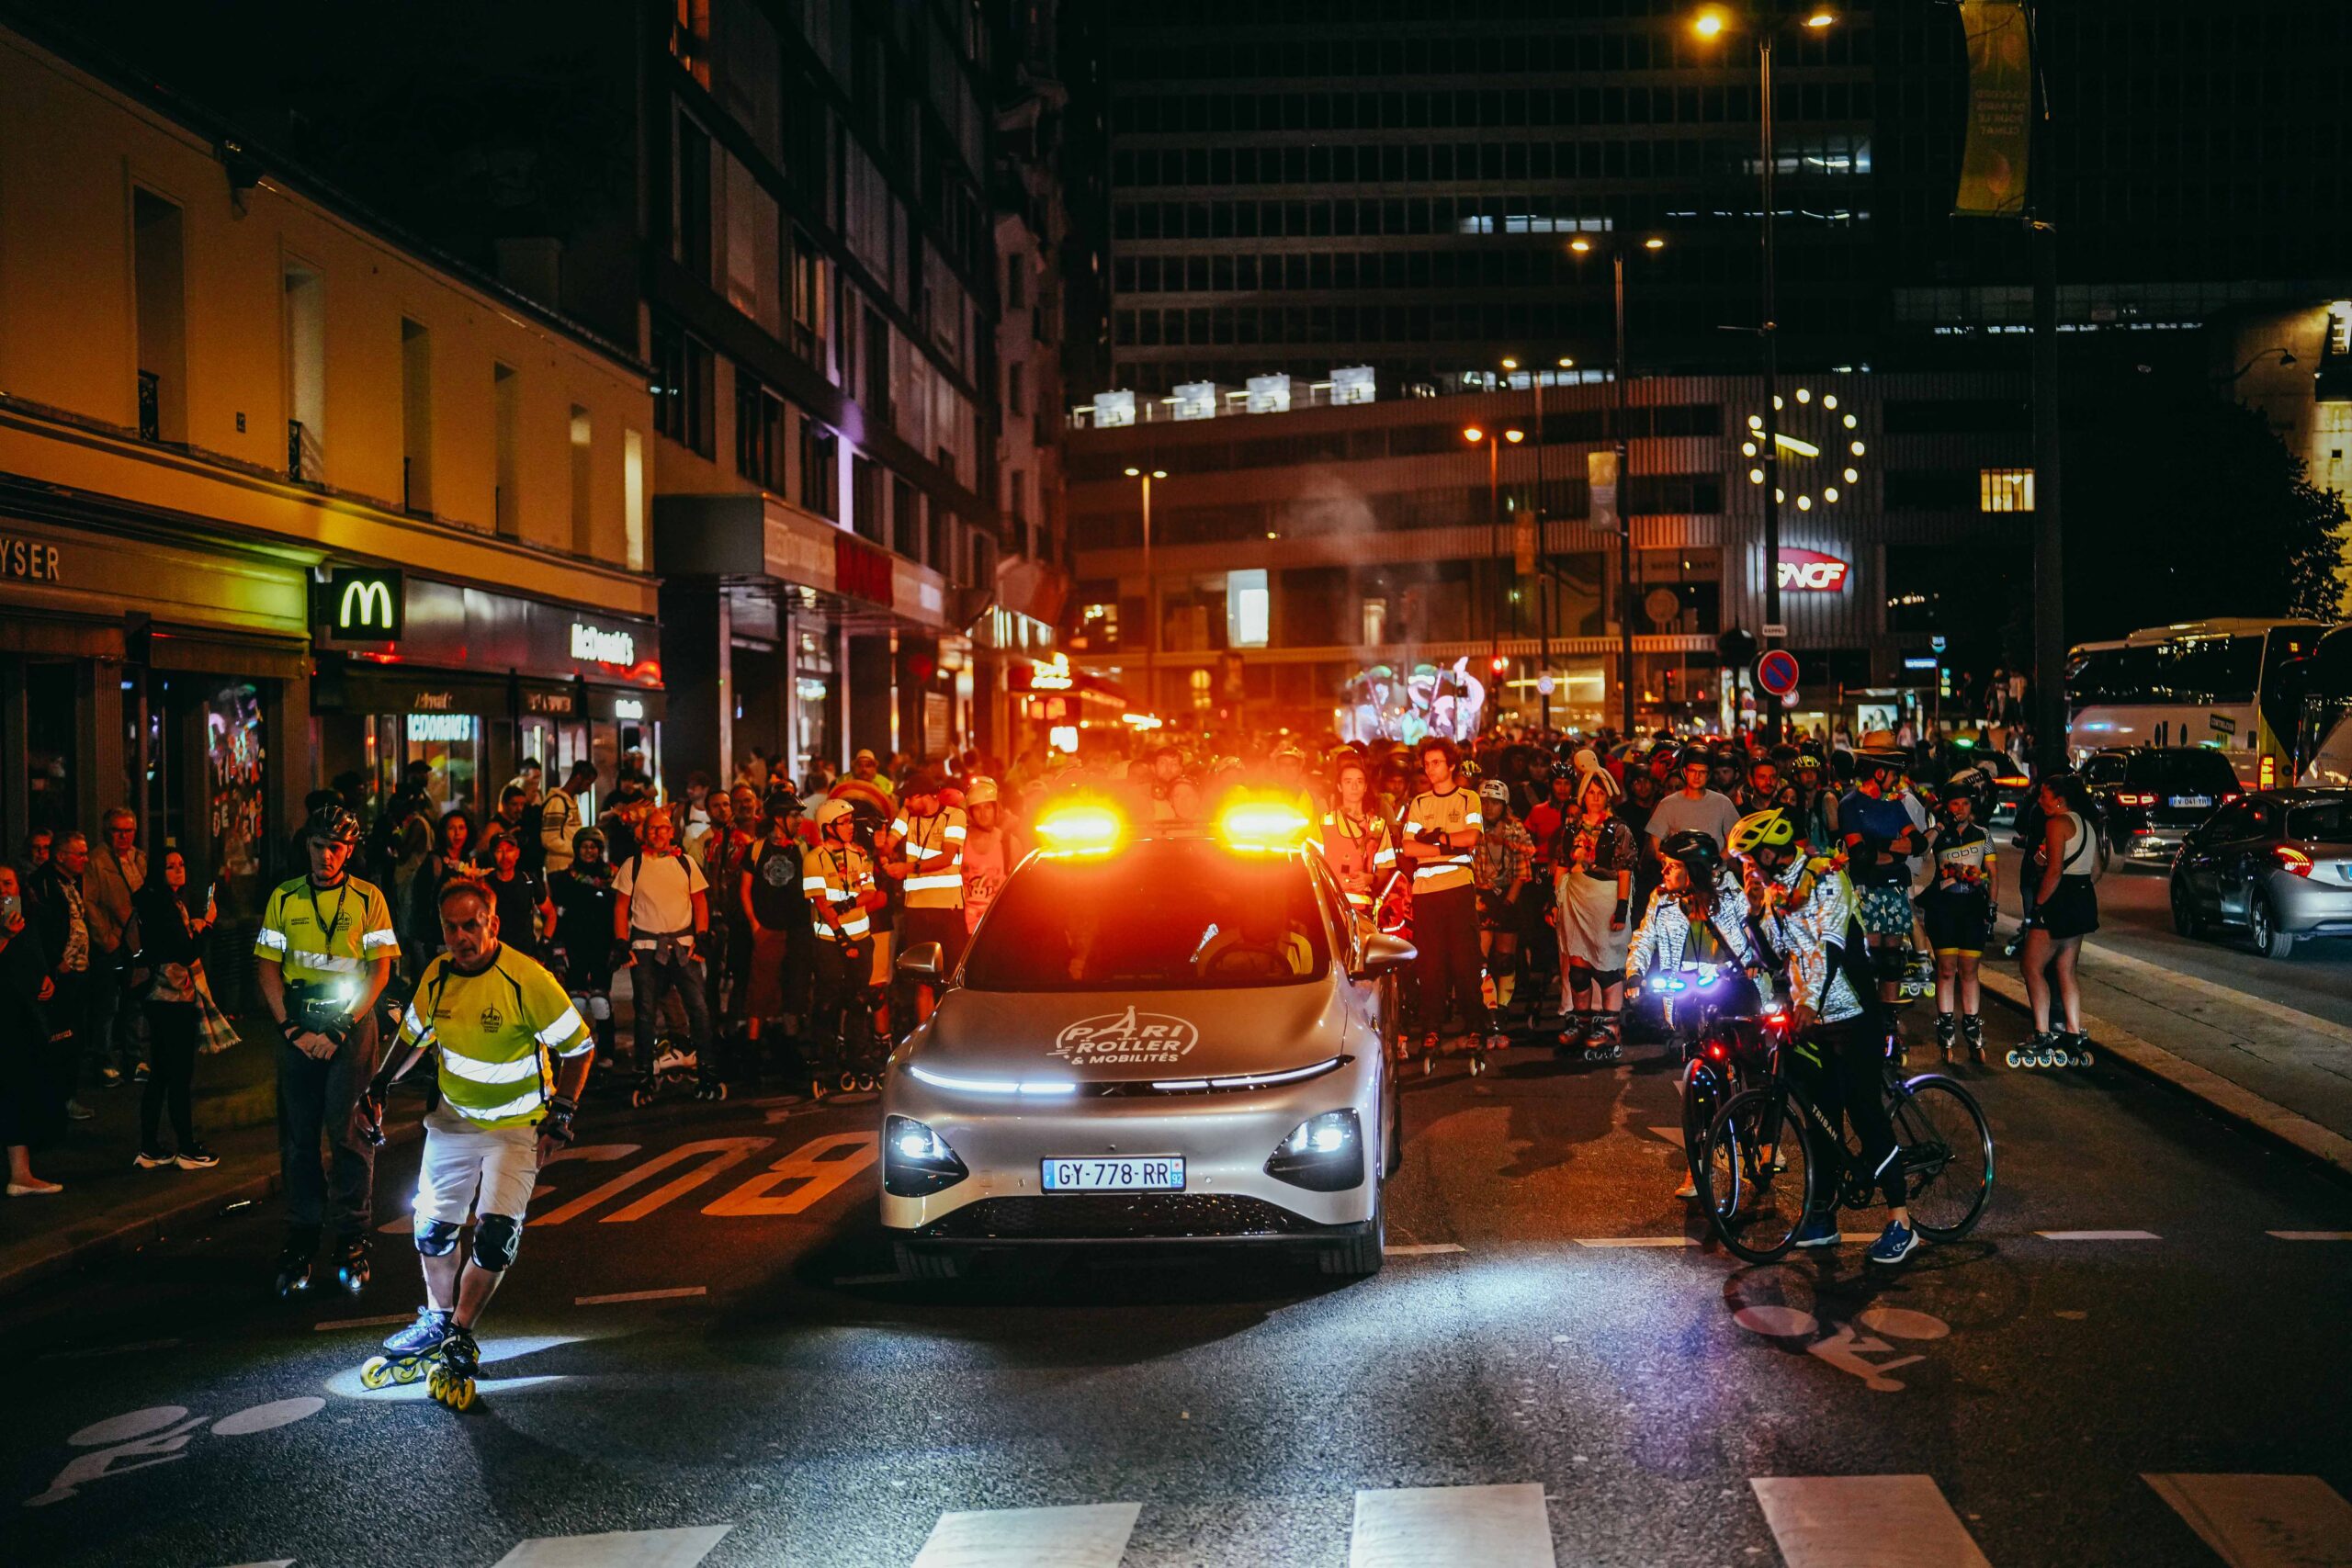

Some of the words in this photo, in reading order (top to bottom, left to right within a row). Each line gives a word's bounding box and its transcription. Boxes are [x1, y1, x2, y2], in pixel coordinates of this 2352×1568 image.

[0, 538, 60, 581] YSER
[1065, 1005, 1183, 1041] PARI
[1076, 1040, 1182, 1054] ROLLER
[1071, 1056, 1084, 1066] &
[1089, 1053, 1179, 1065] MOBILITÉS
[1812, 1103, 1838, 1141] TRIBAN
[1058, 1163, 1169, 1186] GY-778-RR
[1171, 1173, 1183, 1185] 92
